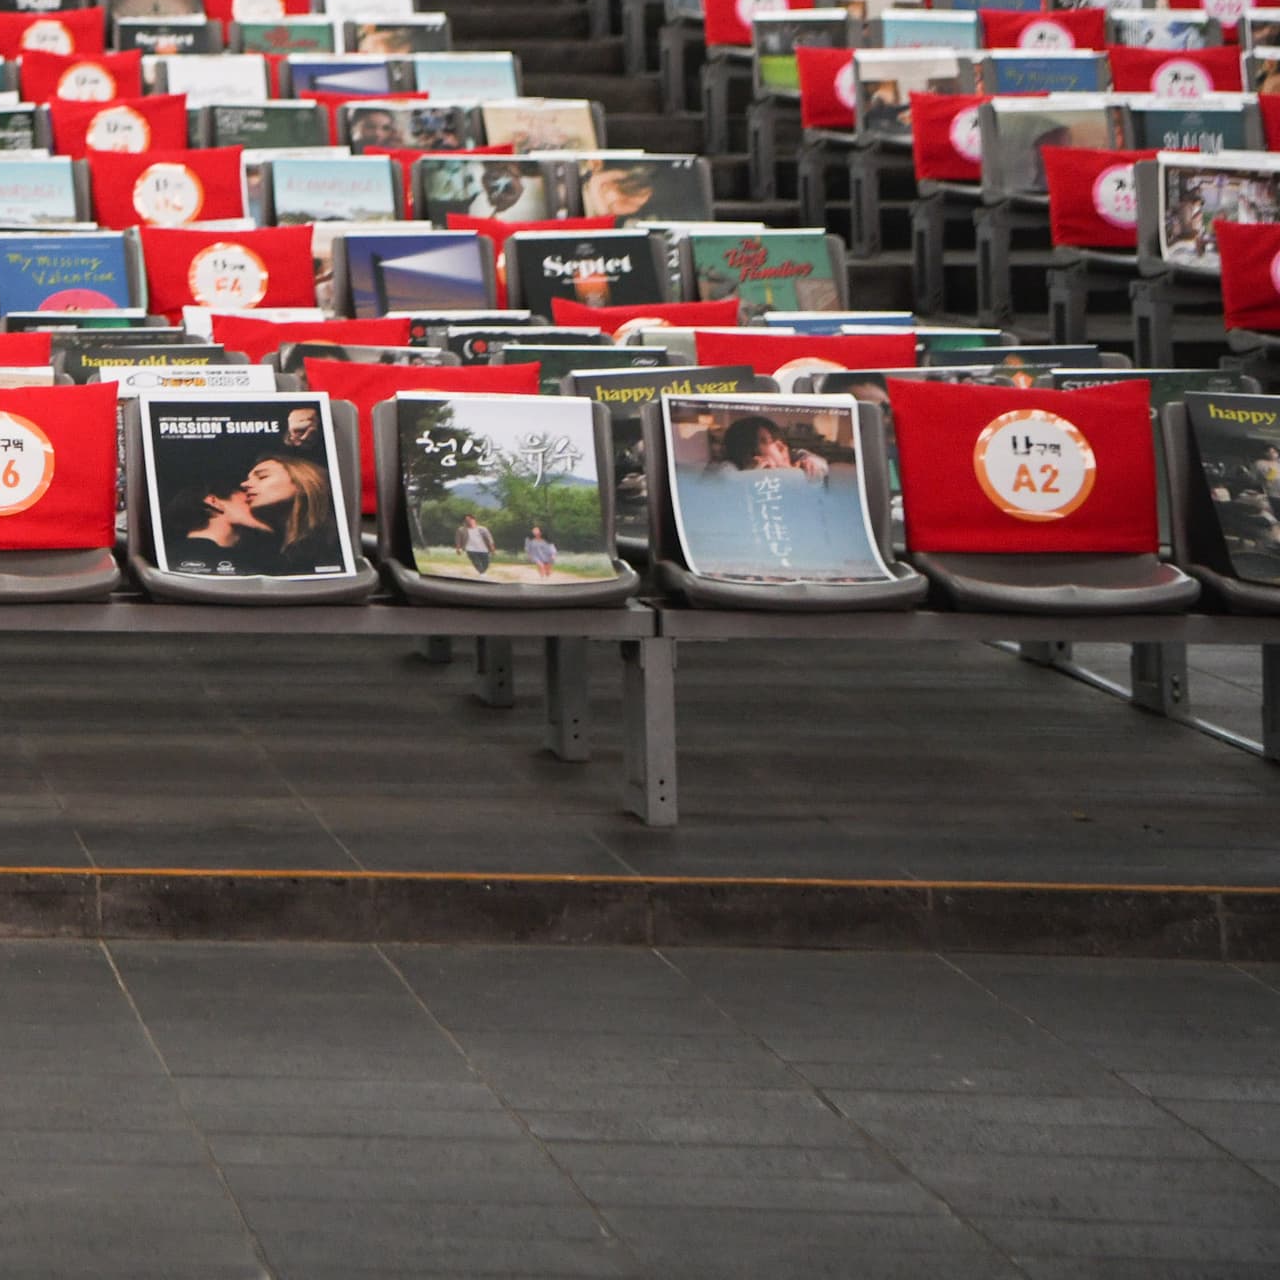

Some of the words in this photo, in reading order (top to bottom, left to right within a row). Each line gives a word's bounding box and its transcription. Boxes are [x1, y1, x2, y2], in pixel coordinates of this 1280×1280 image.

[543, 254, 633, 279] Septet
[81, 355, 135, 367] happy
[138, 355, 168, 366] old
[171, 357, 210, 366] year
[595, 384, 656, 404] happy
[660, 379, 693, 395] old
[695, 380, 739, 394] year
[1208, 403, 1278, 425] happy
[159, 421, 223, 435] PASSION
[226, 420, 280, 434] SIMPLE
[1012, 463, 1062, 494] A2
